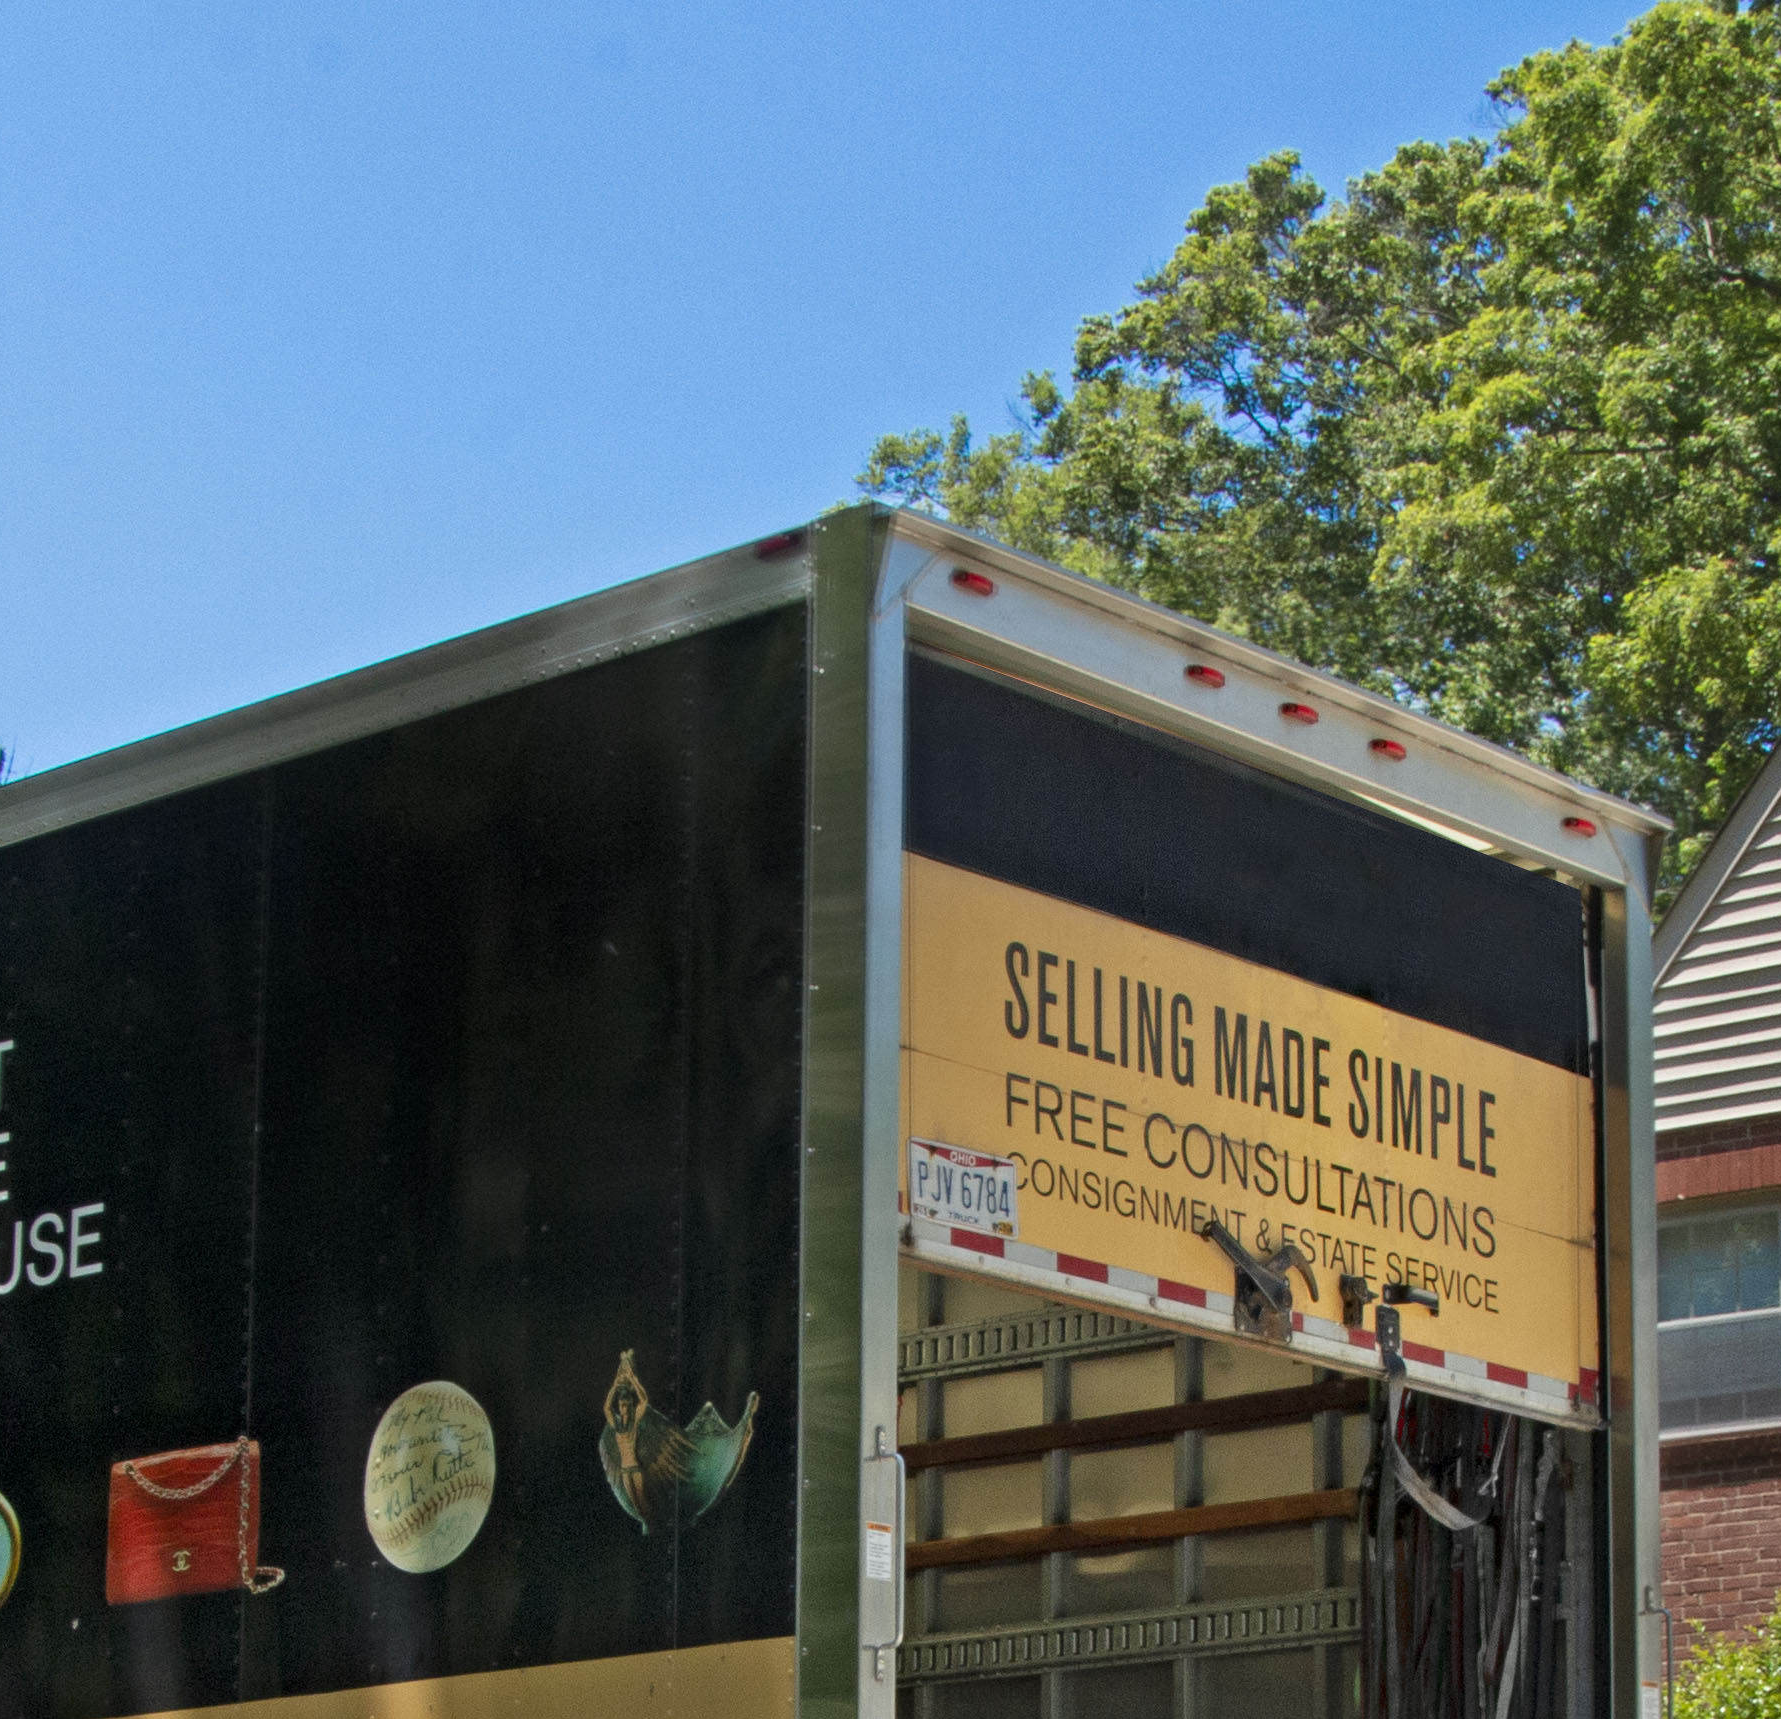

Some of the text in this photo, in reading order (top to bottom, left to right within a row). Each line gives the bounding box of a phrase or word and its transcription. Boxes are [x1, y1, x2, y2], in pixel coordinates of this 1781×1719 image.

[1004, 941, 1497, 1177] SELLING MADE SIMPLE
[918, 1160, 1010, 1218] PJV 6784
[950, 1151, 976, 1167] OHIO
[1004, 1073, 1497, 1259] FREE CONSULTATIONS
[1006, 1151, 1500, 1314] CONSIGNMENT & ESTATE SERVICE
